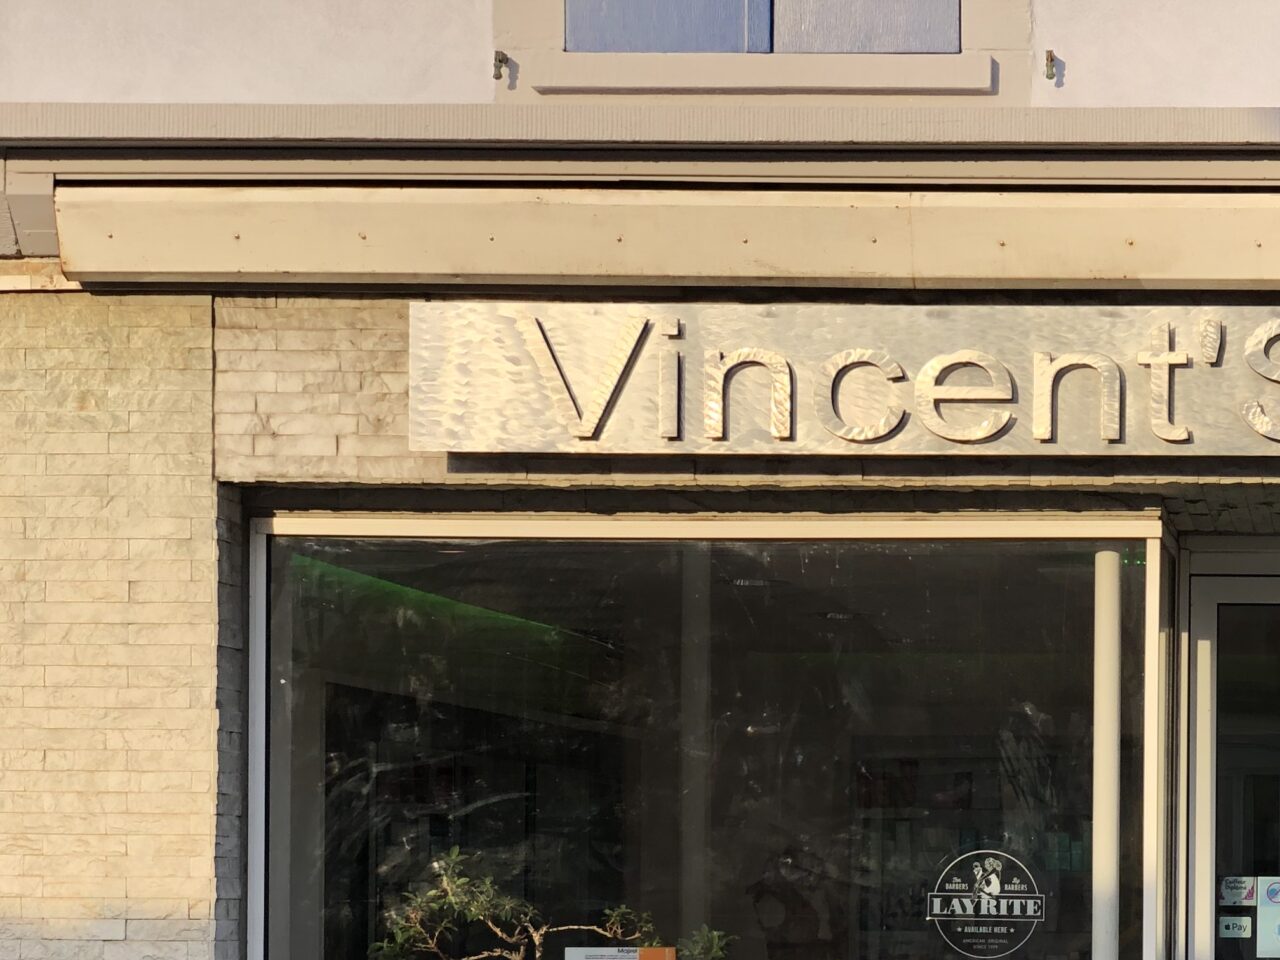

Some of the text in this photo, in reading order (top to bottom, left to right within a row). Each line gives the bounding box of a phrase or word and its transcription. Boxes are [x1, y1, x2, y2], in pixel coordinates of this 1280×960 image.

[1004, 883, 1028, 891] BARBERS
[931, 898, 1041, 916] LAYRITE
[1231, 923, 1248, 932] Pay
